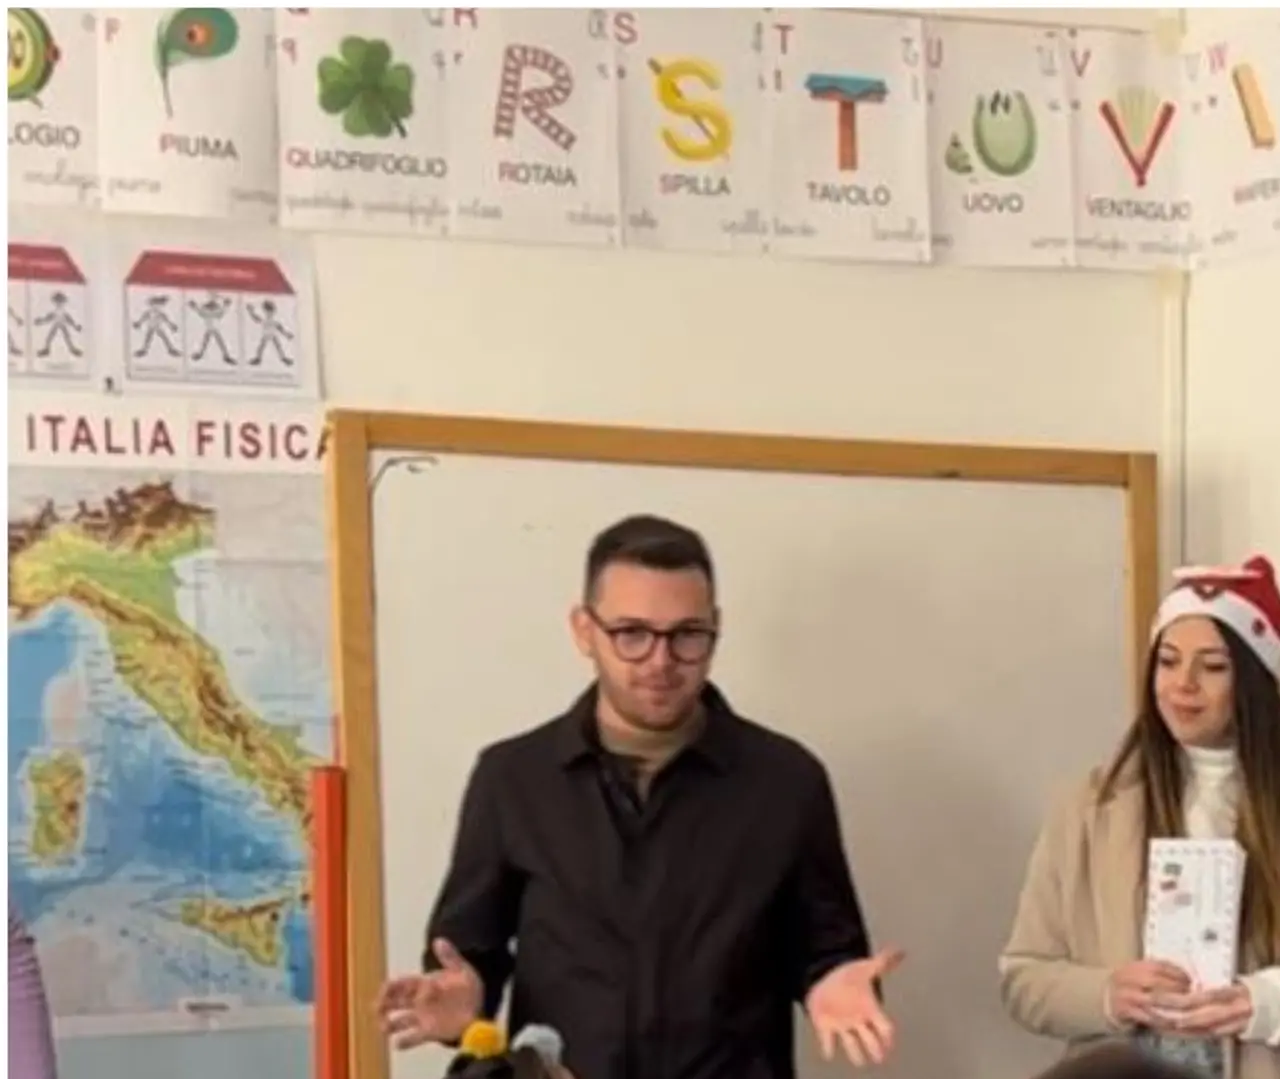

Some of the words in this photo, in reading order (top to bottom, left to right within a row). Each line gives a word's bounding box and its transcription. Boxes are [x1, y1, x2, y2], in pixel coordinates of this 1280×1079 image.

[613, 11, 639, 45] S
[773, 24, 794, 55] T
[1069, 49, 1092, 78] V
[159, 132, 239, 161] PIUMA
[285, 147, 448, 179] QUADRIFOGLIO
[498, 161, 578, 188] ROTAIA
[659, 172, 733, 197] SPILLA
[806, 180, 892, 208] TAVOLO
[962, 192, 1025, 214] UOVO
[1086, 197, 1193, 222] VENTAGLIO
[25, 413, 176, 458] ITALIA
